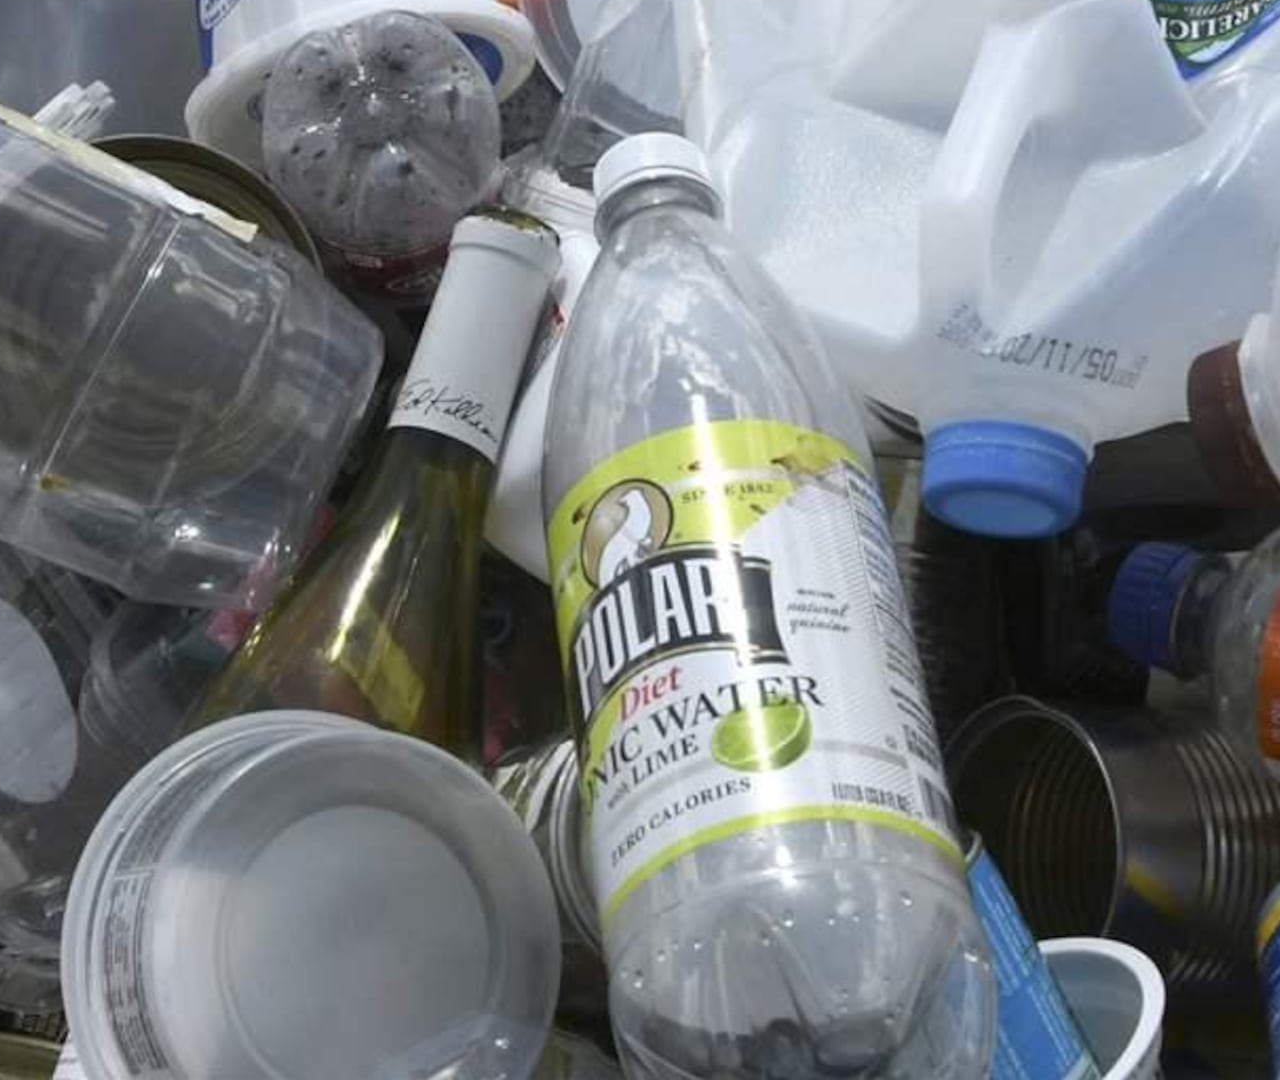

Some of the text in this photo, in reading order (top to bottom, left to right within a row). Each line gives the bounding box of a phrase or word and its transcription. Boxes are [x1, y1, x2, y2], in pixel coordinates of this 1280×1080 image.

[573, 559, 737, 714] POLAR
[619, 665, 682, 722] Diet
[649, 674, 826, 733] WATER
[631, 733, 699, 788] LIME
[610, 777, 753, 867] ZERO CALORIES
